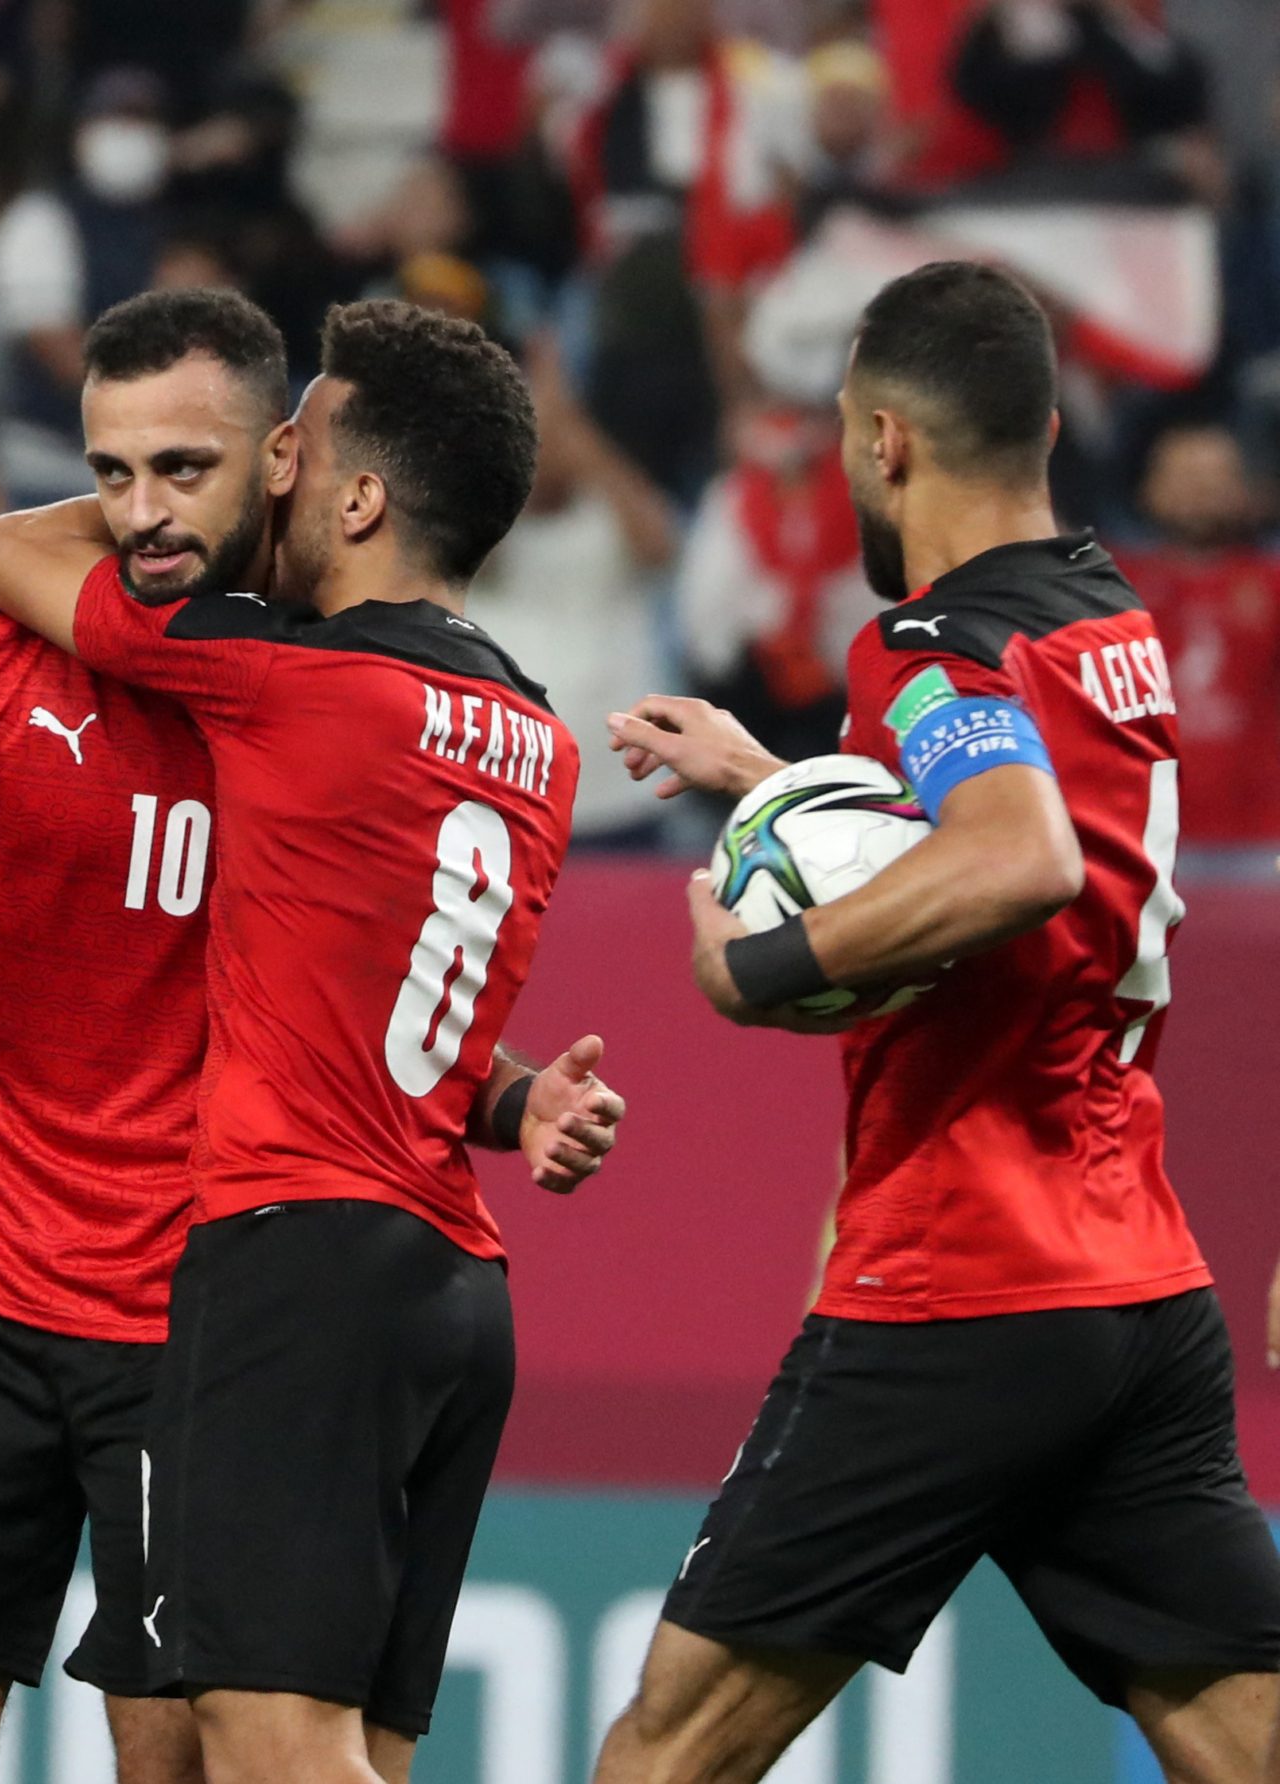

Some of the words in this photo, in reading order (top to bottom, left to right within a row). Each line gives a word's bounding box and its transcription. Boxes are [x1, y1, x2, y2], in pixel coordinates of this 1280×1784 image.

[419, 683, 554, 796] M.FATHY
[966, 736, 1019, 758] FIFA
[124, 793, 211, 917] 10
[385, 801, 514, 1096] 8
